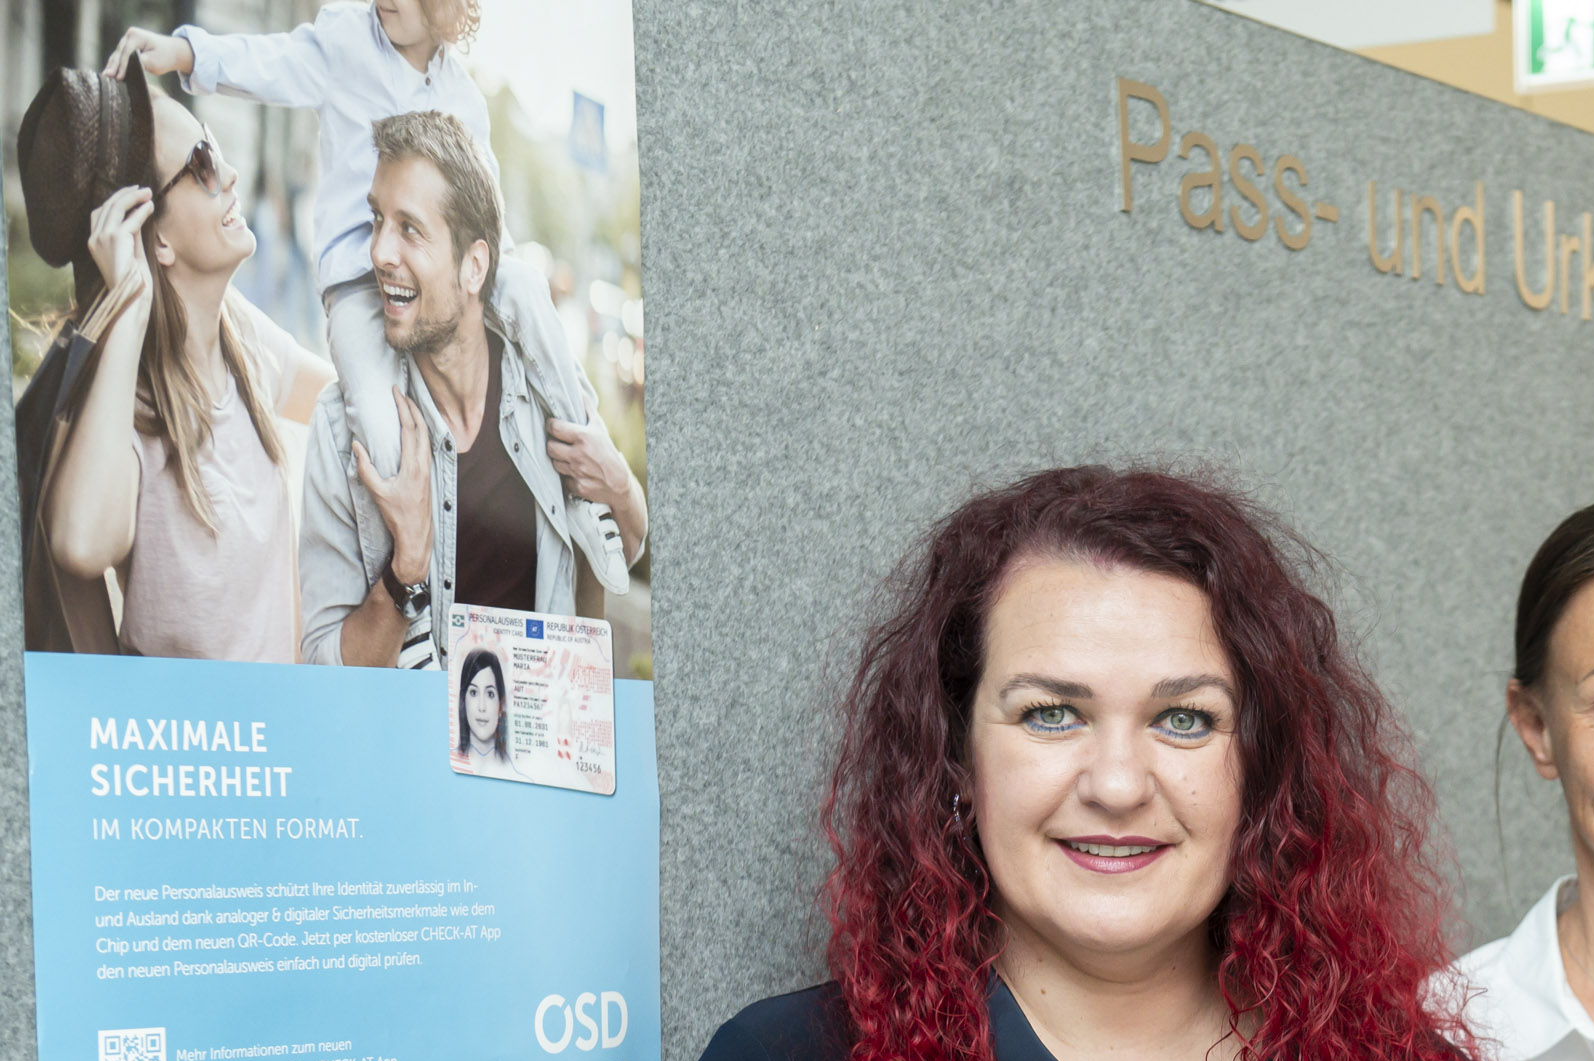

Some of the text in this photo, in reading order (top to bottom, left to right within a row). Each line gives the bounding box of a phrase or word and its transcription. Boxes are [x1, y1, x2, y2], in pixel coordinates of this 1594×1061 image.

[1117, 76, 1339, 251] Pass-
[1369, 180, 1487, 296] und
[469, 613, 524, 627] PERSONALAUSWEIS
[546, 623, 575, 633] REPUBLIK
[90, 717, 267, 752] MAXIMALE
[576, 761, 602, 774] 123456
[91, 763, 292, 797] SICHERHEIT
[92, 818, 364, 840] IM KOMPAKTEN FORMAT.
[94, 880, 478, 901] Der neue Personalausweis schützt Ihre Identität zuverlässig im In-
[95, 902, 495, 927] und Ausland dank analoger & digitaler Sicherheitsmerkmale wie dem
[96, 926, 501, 955] Chip und dem neuen QR-Code. Jetzt per kostenloser CHECK-AT App
[97, 952, 423, 979] den neuen Personalausweis einfach und digital prüfen.
[176, 1040, 352, 1061] Mehr Informationen zum neuen
